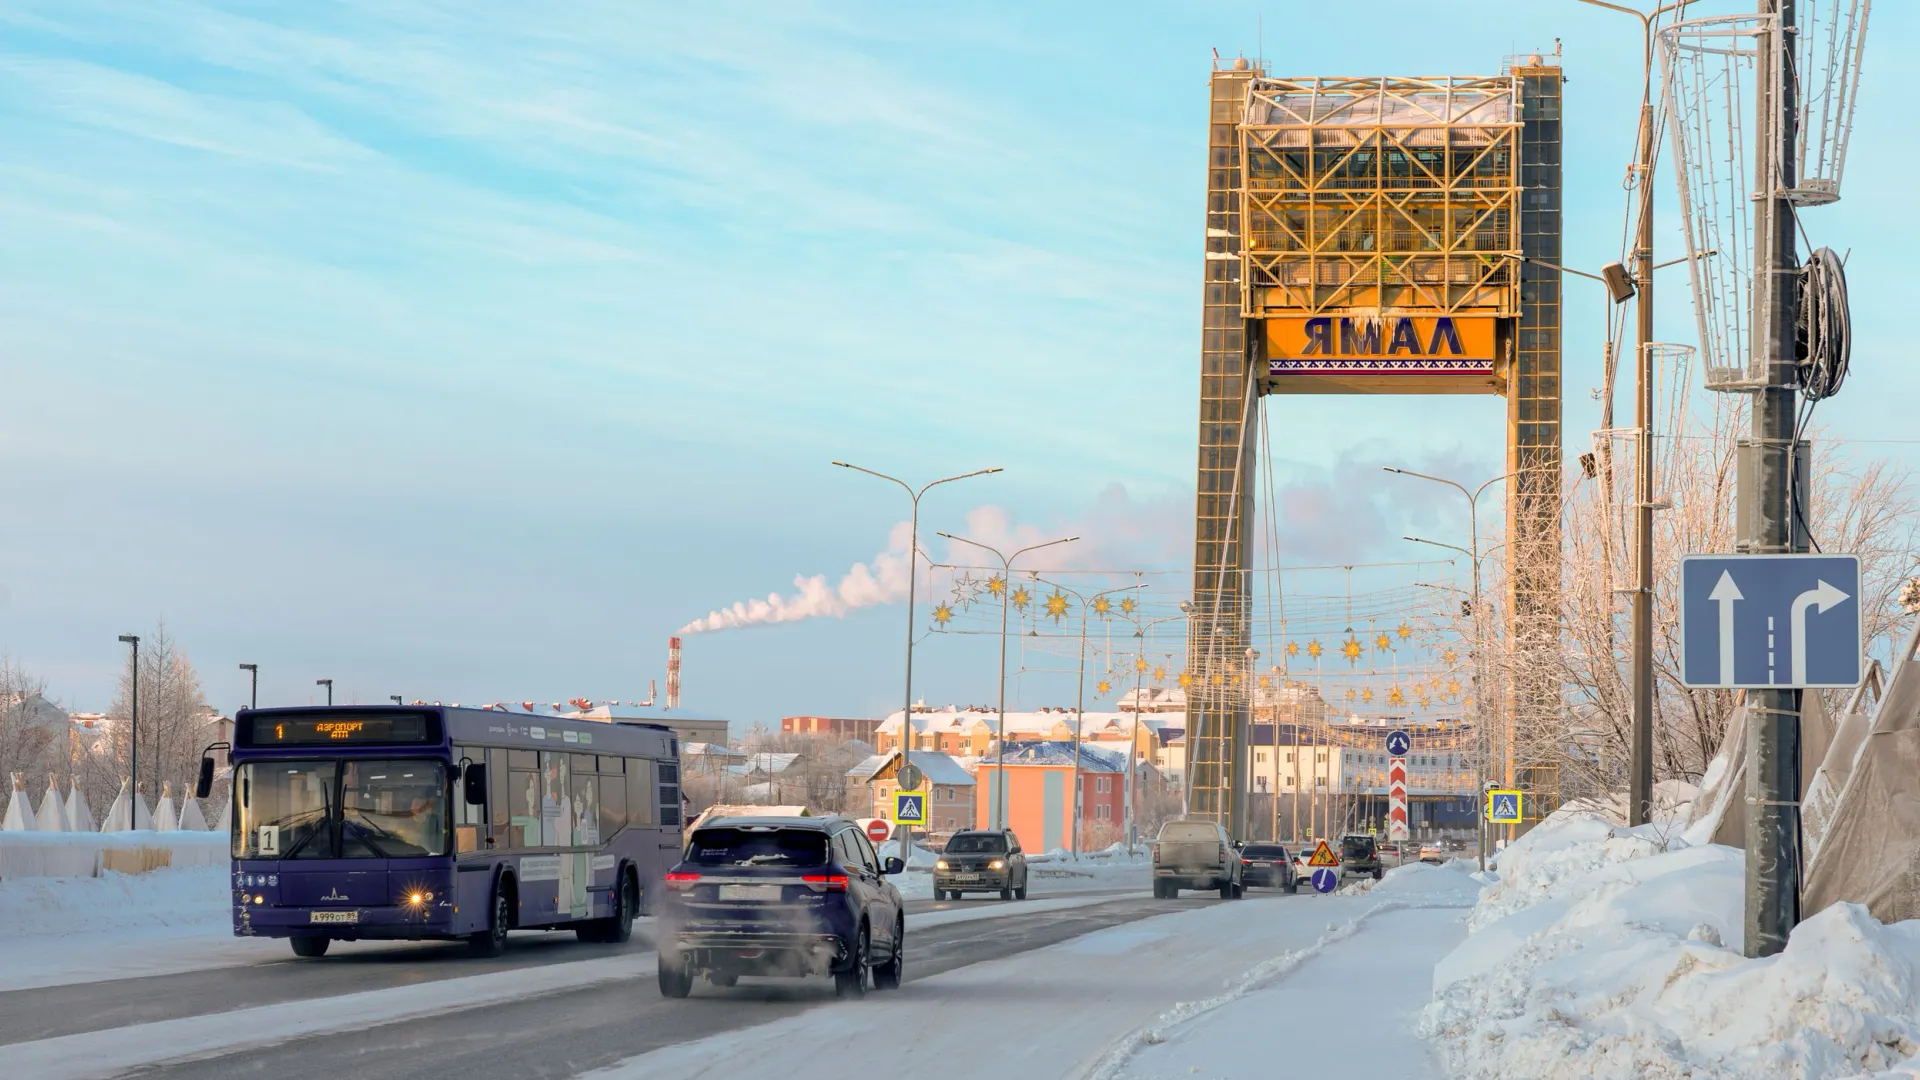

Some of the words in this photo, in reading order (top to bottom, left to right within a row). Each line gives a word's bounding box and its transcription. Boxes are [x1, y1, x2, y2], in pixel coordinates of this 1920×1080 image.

[1301, 317, 1464, 355] ЯМАЛ
[275, 723, 283, 739] 1
[316, 722, 363, 732] АЭРОПОРТ
[263, 830, 274, 851] 1
